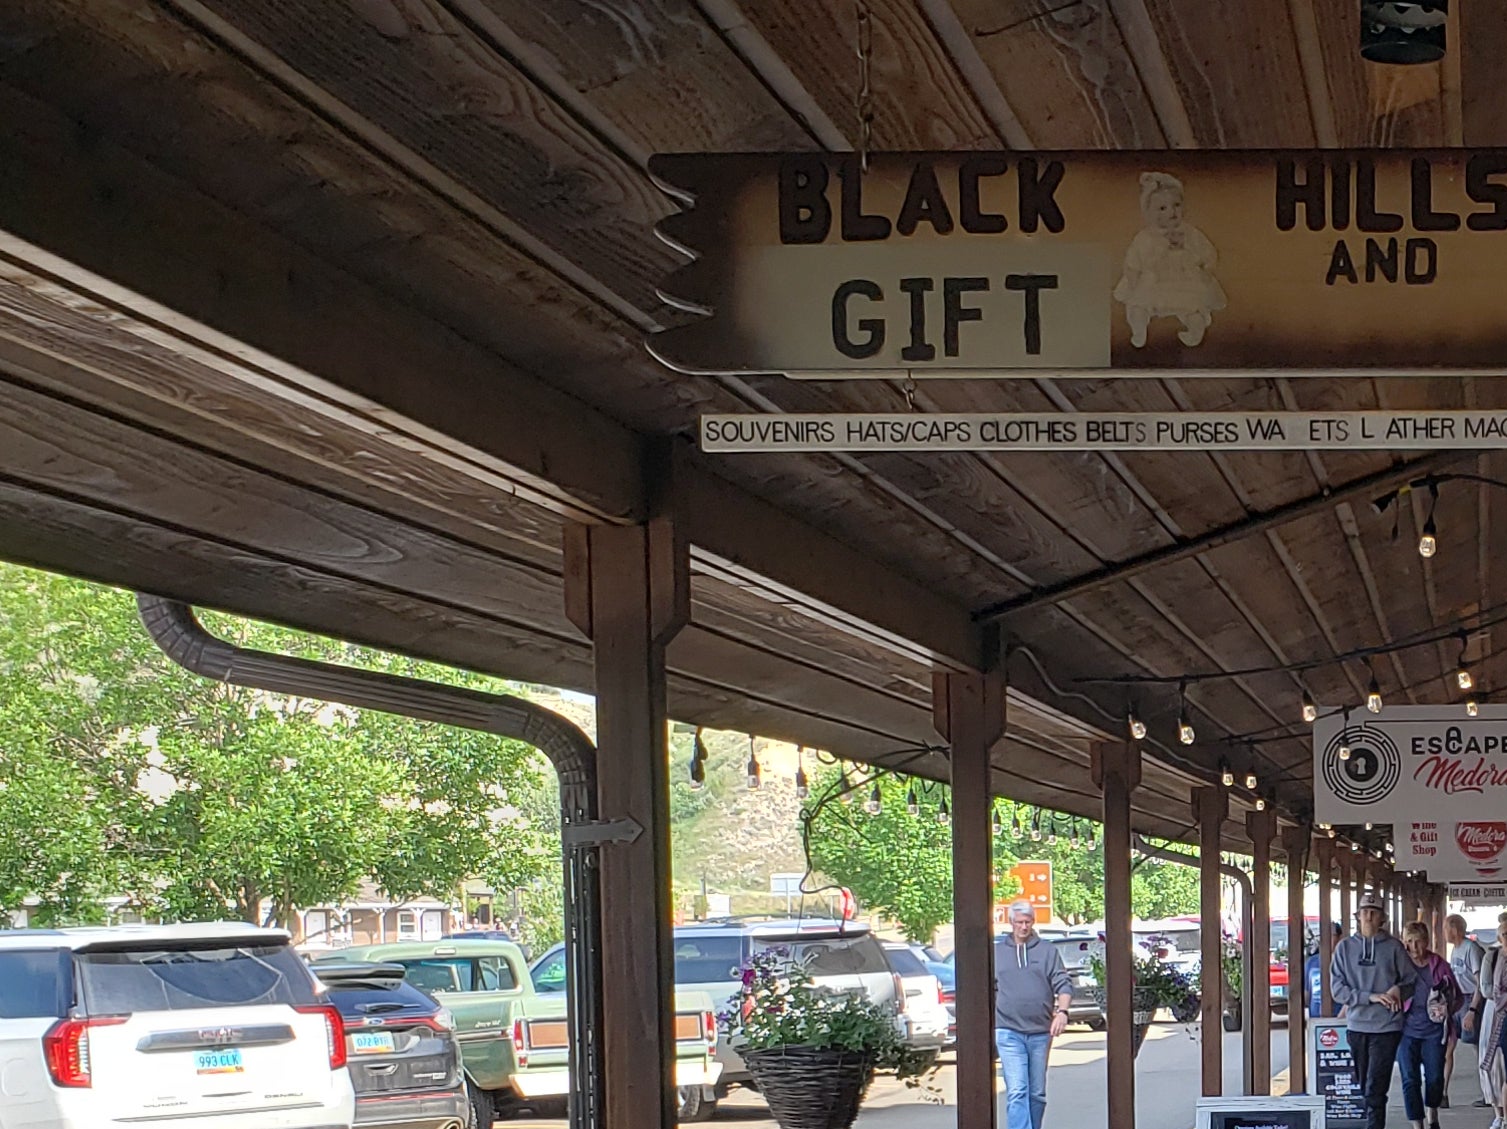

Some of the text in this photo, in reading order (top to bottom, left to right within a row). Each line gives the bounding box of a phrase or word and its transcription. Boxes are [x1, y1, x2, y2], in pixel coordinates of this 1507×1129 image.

[778, 156, 1065, 244] BLACK
[832, 273, 1059, 361] GIFT
[1325, 236, 1437, 285] AND
[705, 420, 836, 443] SOUVENIRS
[846, 420, 972, 444] HATS/CAPS
[979, 420, 1078, 444] CLOTHES
[1085, 420, 1147, 444] BELTS
[1156, 420, 1240, 444] PURSES
[1412, 844, 1437, 857] Shop
[199, 1054, 239, 1068] 993 CLK
